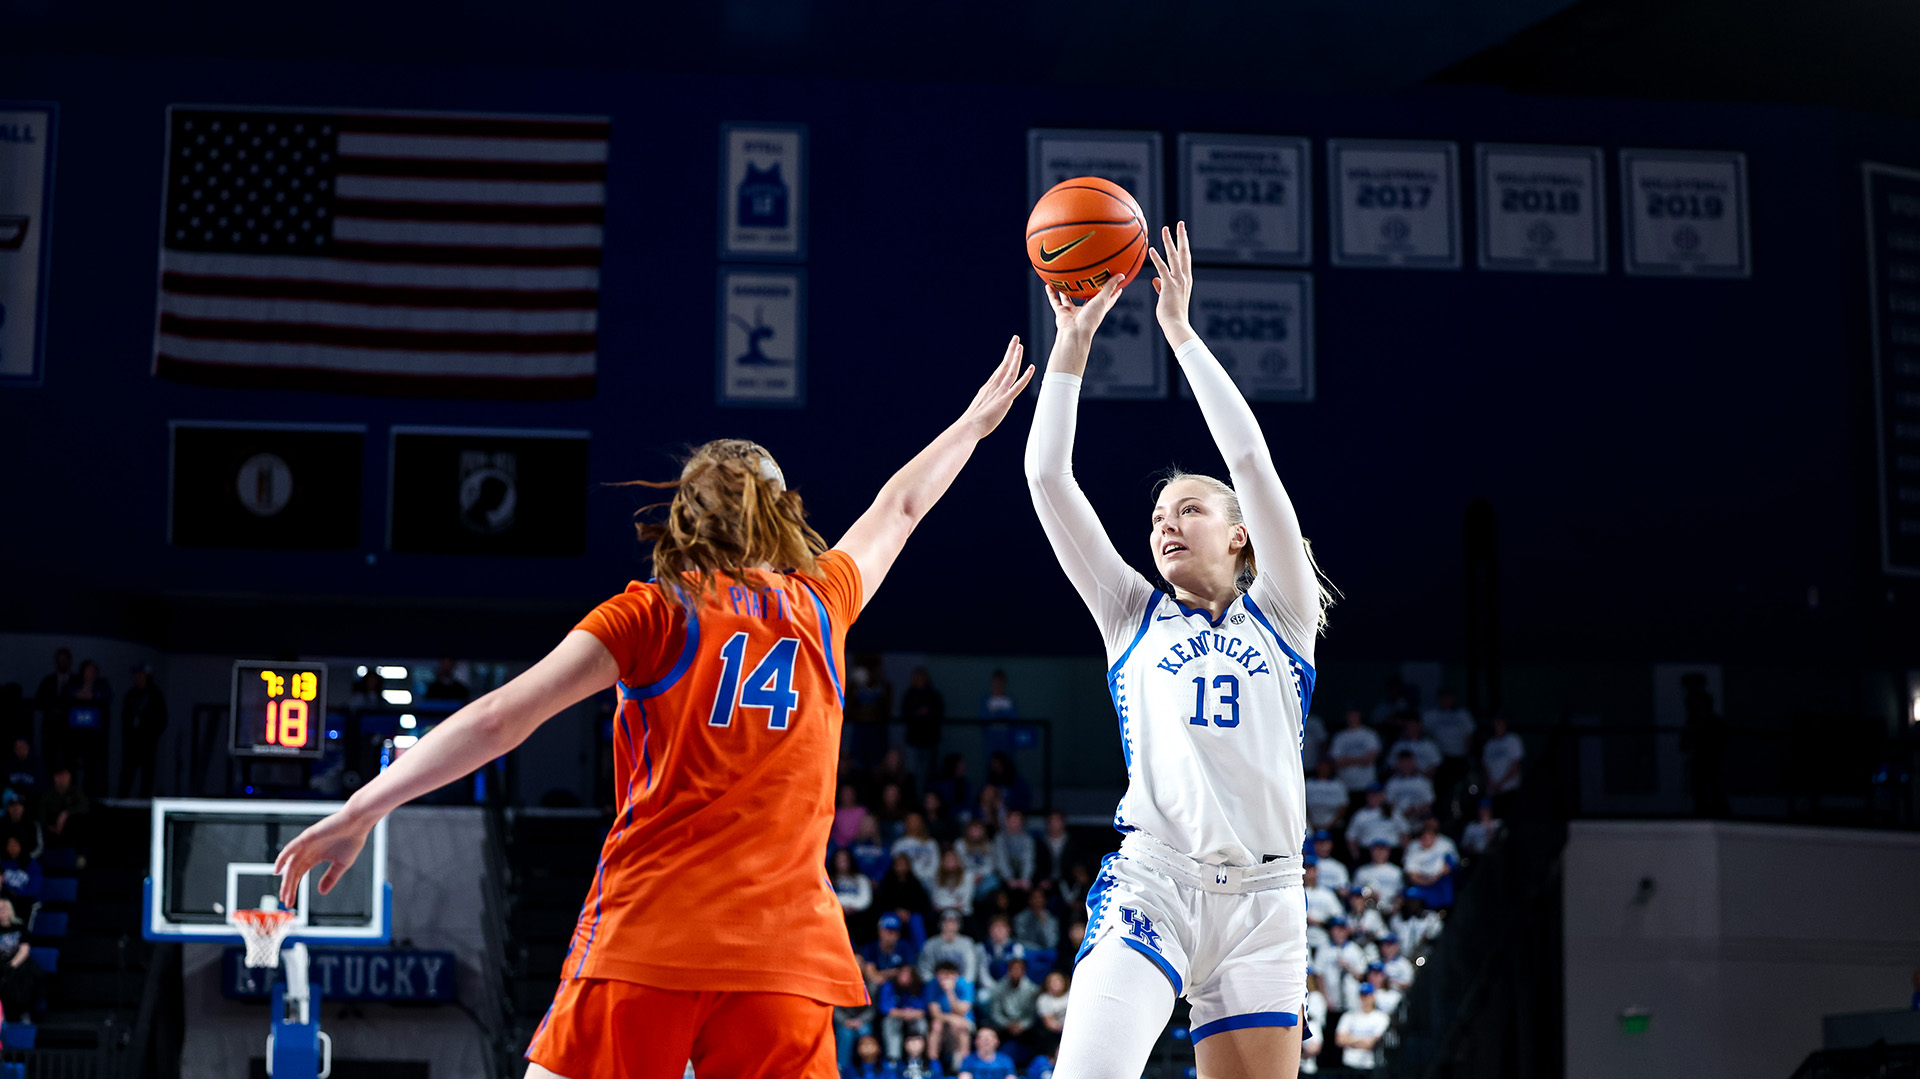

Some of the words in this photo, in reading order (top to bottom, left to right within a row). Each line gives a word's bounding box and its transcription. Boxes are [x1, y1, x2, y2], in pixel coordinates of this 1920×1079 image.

[1207, 180, 1283, 204] 2012
[1357, 186, 1431, 209] 2017
[1502, 189, 1580, 214] 2018
[1648, 194, 1723, 219] 2019
[1207, 314, 1287, 340] 2025
[1157, 630, 1270, 676] KENTUCKY
[260, 670, 317, 701] 7:13
[708, 631, 801, 730] 14
[1189, 675, 1240, 728] 13
[265, 699, 308, 748] 18
[1119, 905, 1163, 954] UK
[233, 953, 445, 997] KTUCKY
